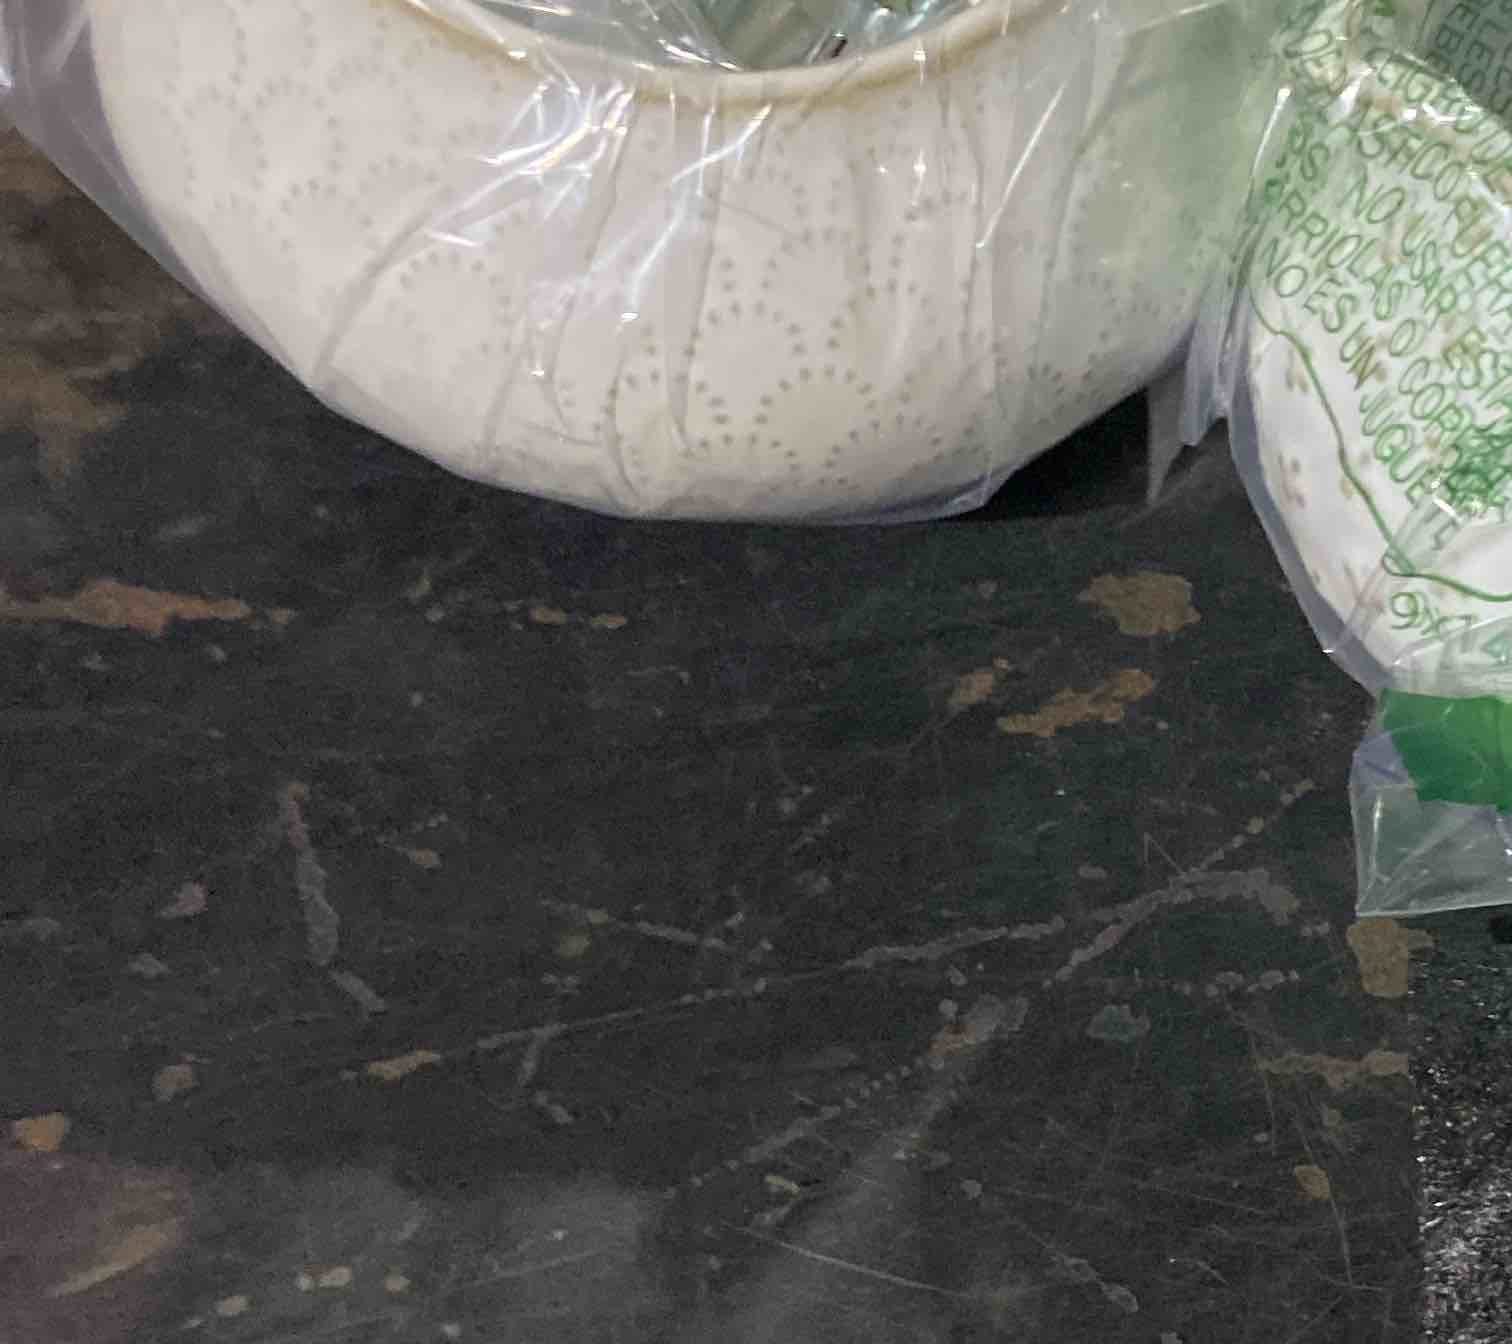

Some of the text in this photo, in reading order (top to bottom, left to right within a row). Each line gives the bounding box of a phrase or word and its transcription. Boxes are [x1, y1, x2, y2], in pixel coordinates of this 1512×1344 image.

[1335, 163, 1405, 224] NO
[1262, 236, 1308, 298] NO
[1303, 273, 1361, 333] ES
[1339, 320, 1380, 391] UN
